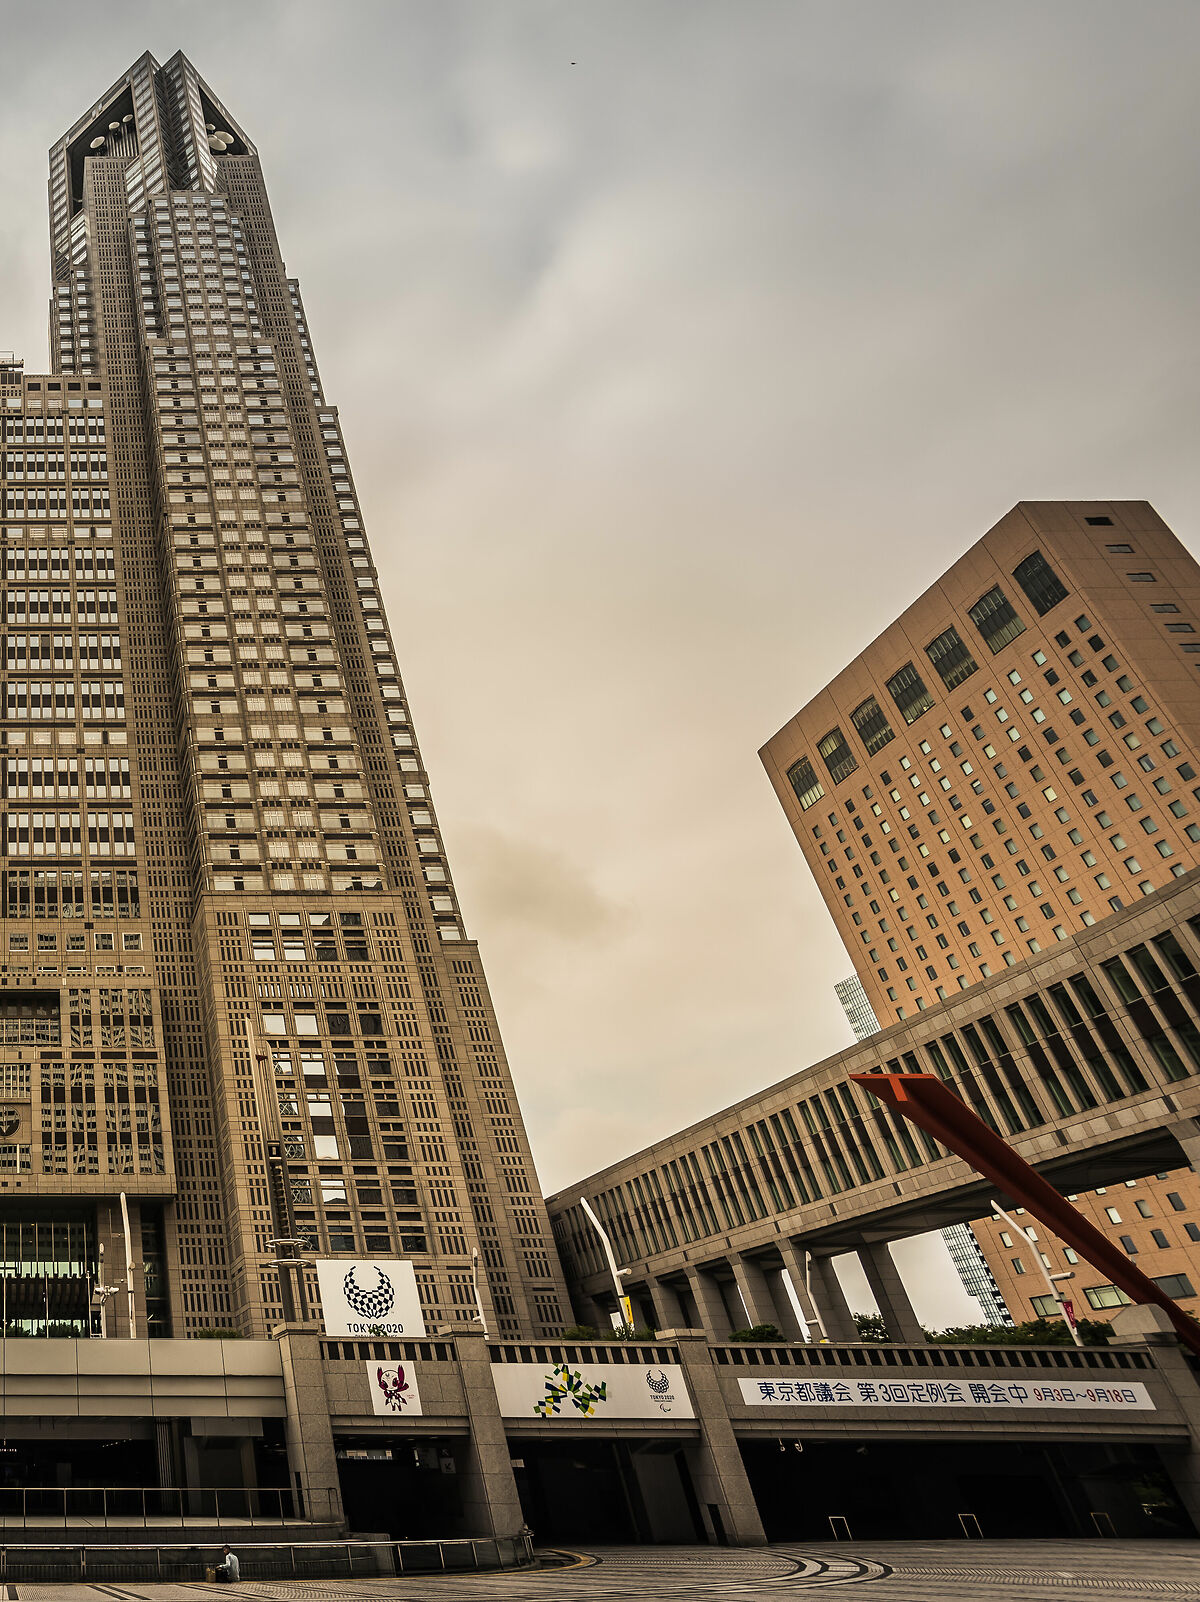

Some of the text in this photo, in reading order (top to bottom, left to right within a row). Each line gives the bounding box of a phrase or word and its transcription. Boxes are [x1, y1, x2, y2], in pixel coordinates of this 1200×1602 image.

[757, 1382, 854, 1403] 東京都議会
[857, 1382, 966, 1404] 第3回定例会
[968, 1383, 1029, 1404] 開会中
